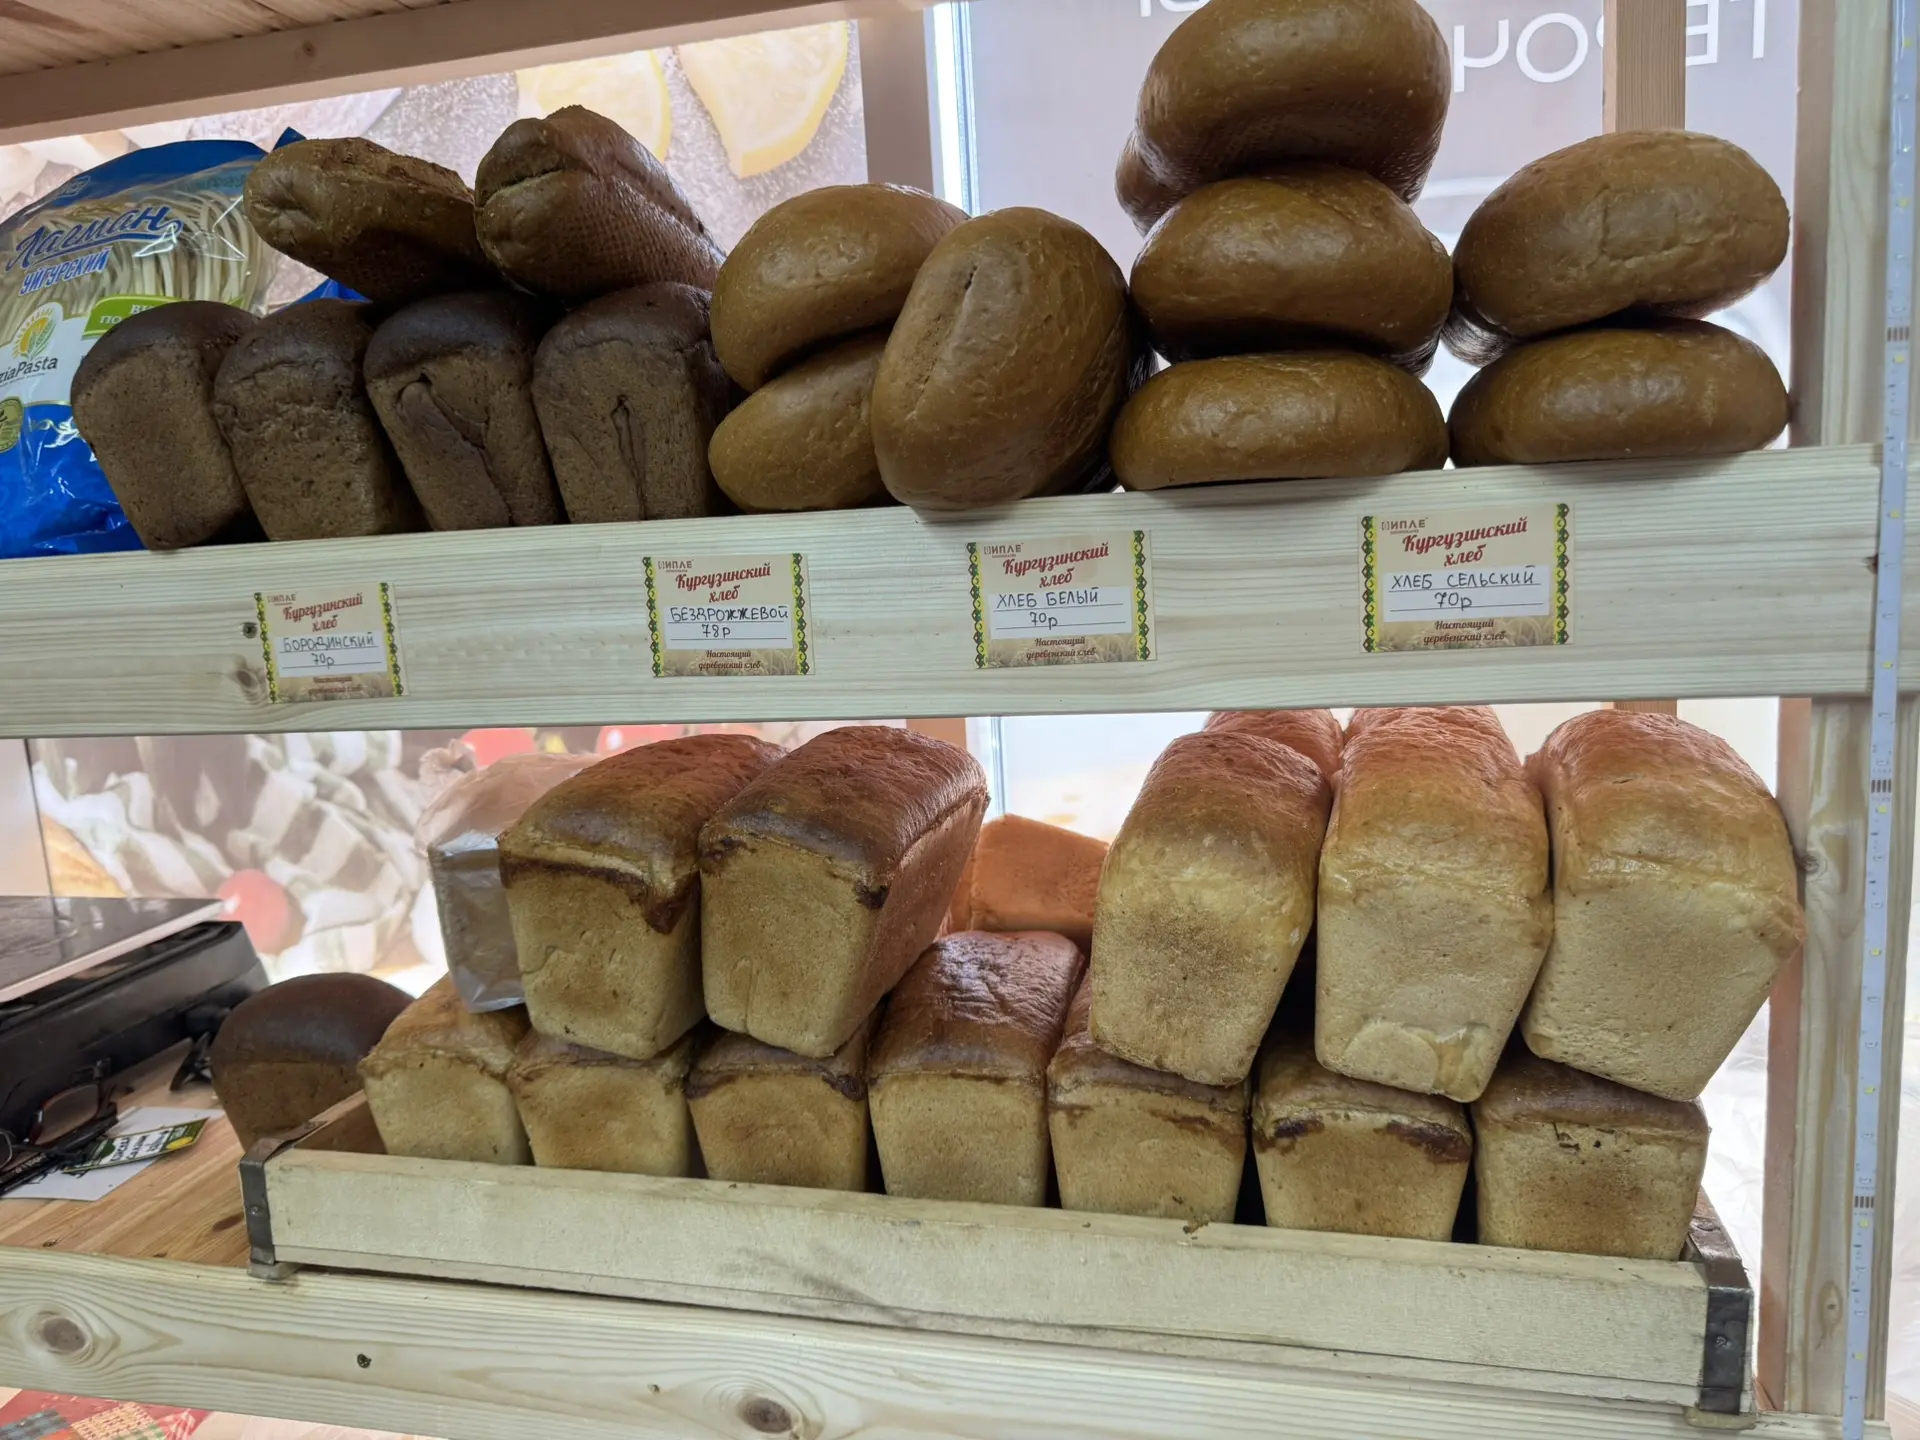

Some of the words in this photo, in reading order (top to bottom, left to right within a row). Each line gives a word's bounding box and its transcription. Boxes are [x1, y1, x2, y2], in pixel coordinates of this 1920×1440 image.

[5, 206, 182, 272] Лагман
[19, 247, 112, 296] УЙГУРСКИЙ
[1402, 517, 1528, 554] Кургузинский
[1003, 542, 1109, 577] Кургузинский
[1444, 544, 1486, 567] хлеб
[675, 563, 771, 592] Кургузинский
[1039, 567, 1075, 588] хлеб
[1391, 573, 1433, 590] ХЛЕБ
[1446, 565, 1536, 588] СЕЛЬСКИЙ
[283, 592, 363, 622] Кургузинский
[708, 585, 740, 603] хлеб
[996, 593, 1037, 608] ХЛЕБ
[1046, 587, 1099, 607] БЕЛЫЙ
[312, 615, 338, 633] хлеб
